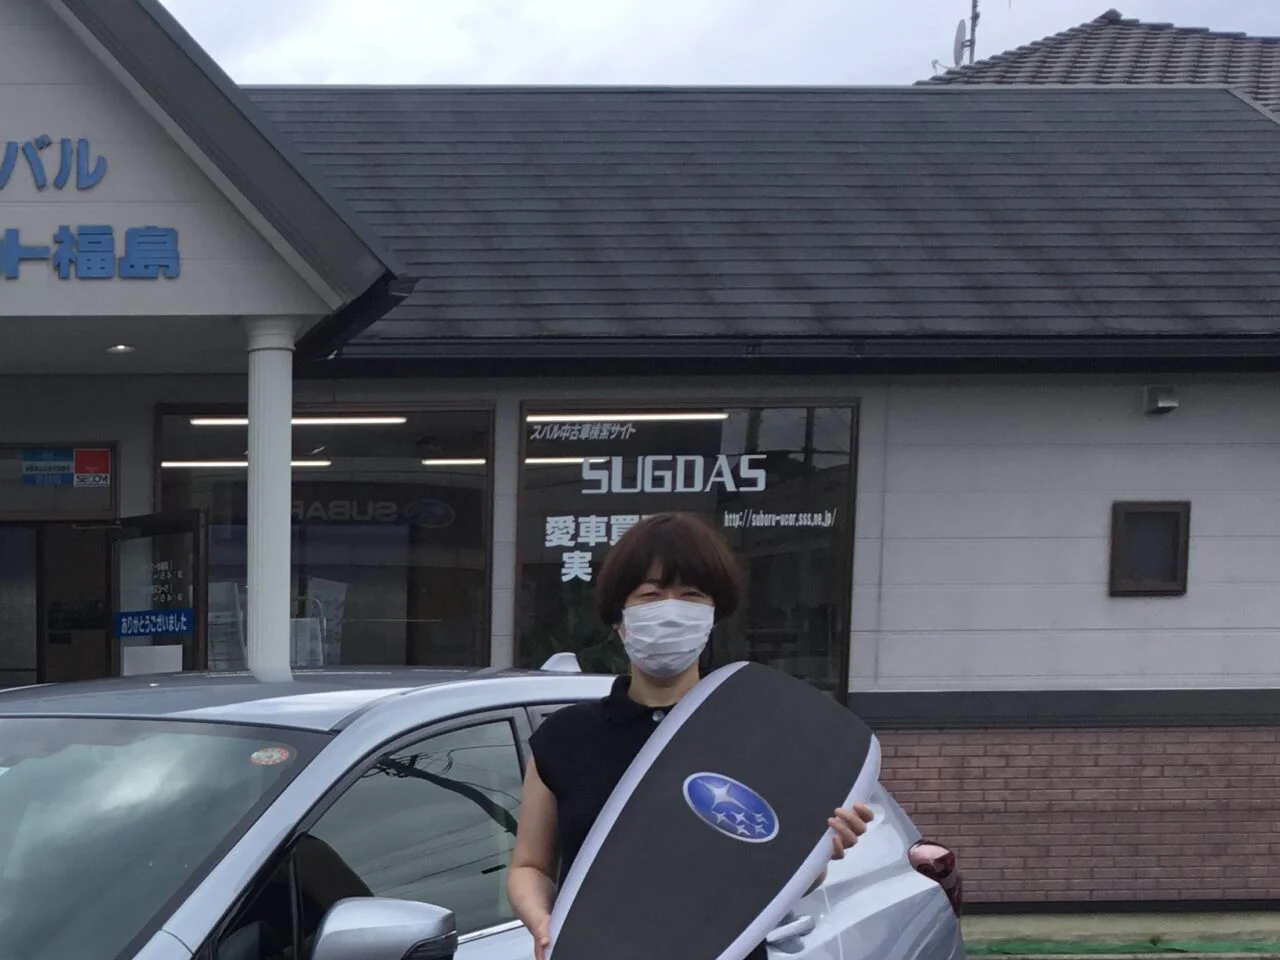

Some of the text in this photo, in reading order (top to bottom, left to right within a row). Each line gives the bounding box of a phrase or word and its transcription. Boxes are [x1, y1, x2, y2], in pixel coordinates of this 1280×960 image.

[530, 423, 636, 440] スバル中古車検索サイト
[545, 514, 657, 547] 愛車買
